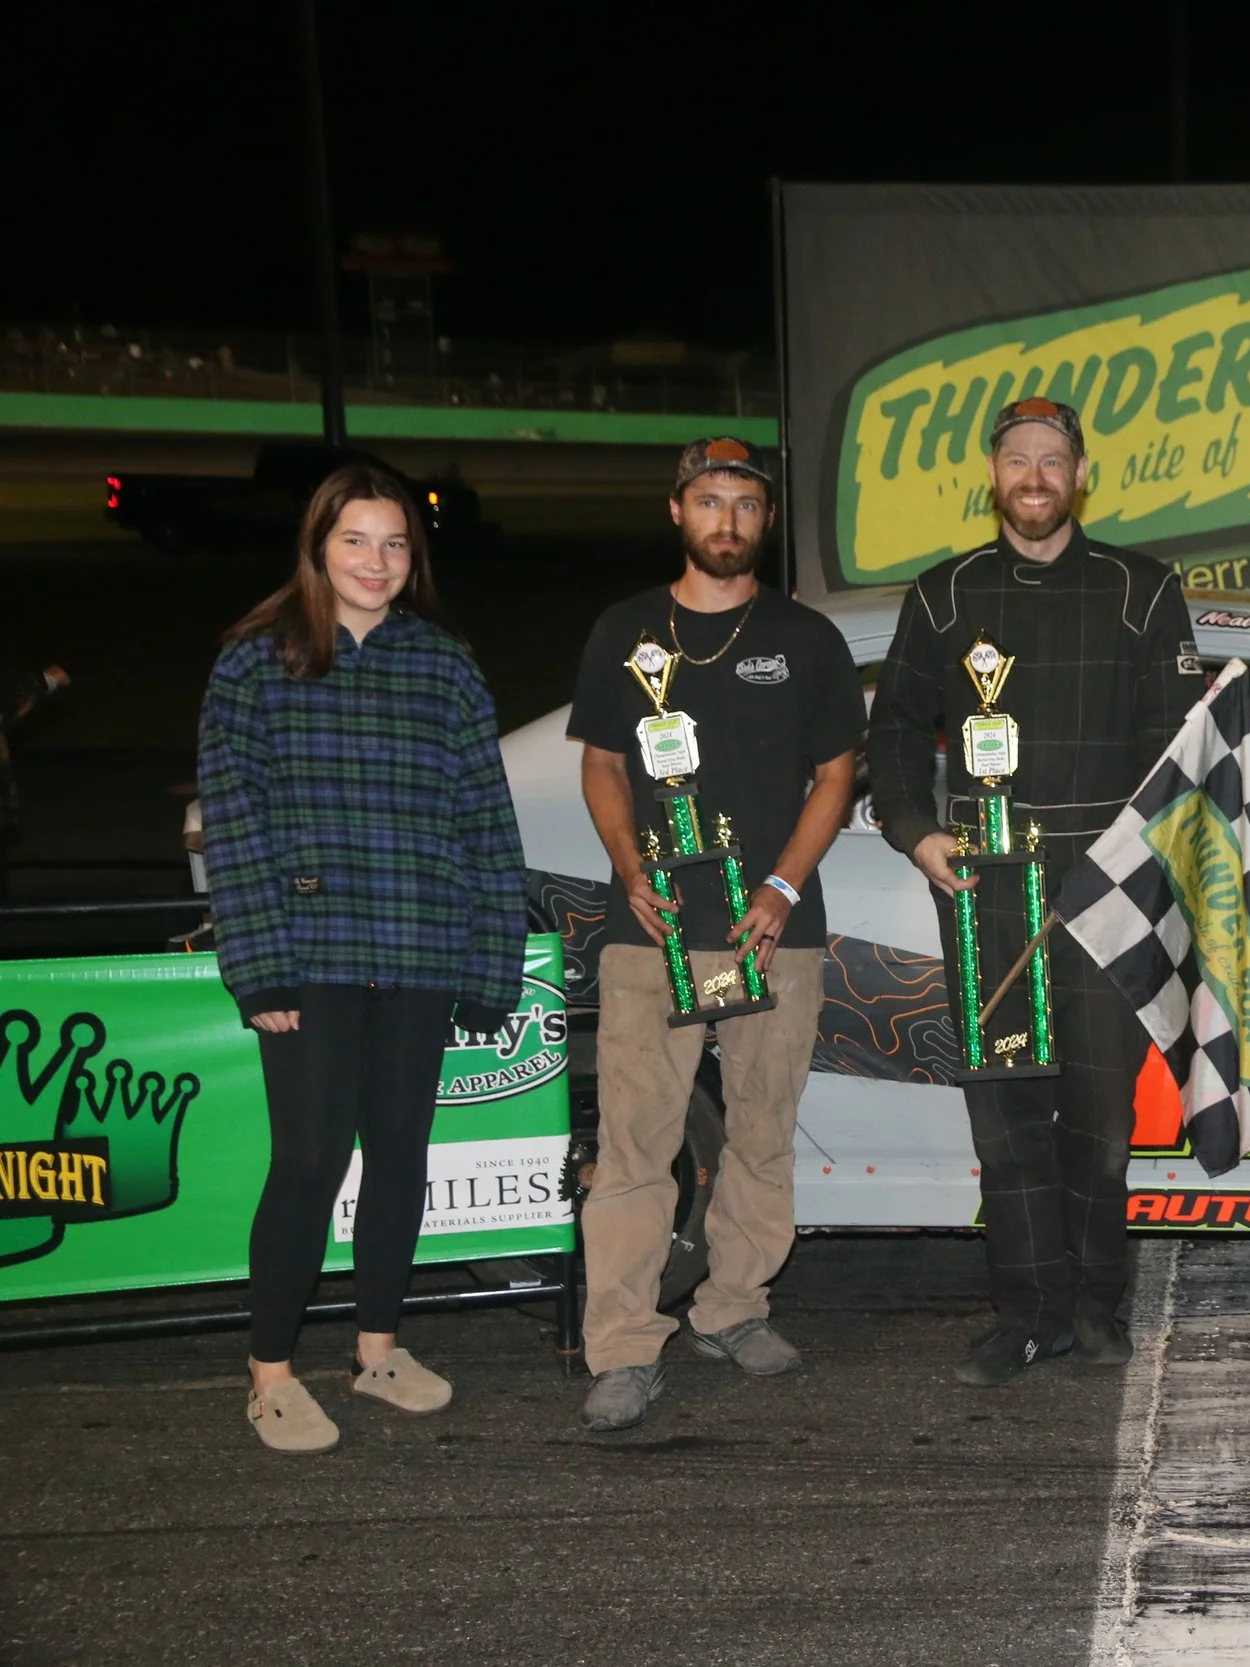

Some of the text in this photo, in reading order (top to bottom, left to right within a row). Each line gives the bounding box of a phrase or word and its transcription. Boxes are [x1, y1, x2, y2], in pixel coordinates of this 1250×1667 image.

[1121, 434, 1185, 491] site
[1203, 412, 1241, 479] of
[704, 969, 737, 995] 2024
[994, 1032, 1028, 1054] 2024
[449, 1051, 561, 1094] APPAREL
[475, 1156, 550, 1169] SINCE 1940
[0, 1151, 107, 1207] NIGHT
[424, 1211, 553, 1228] ATERIALS SUPPLIER
